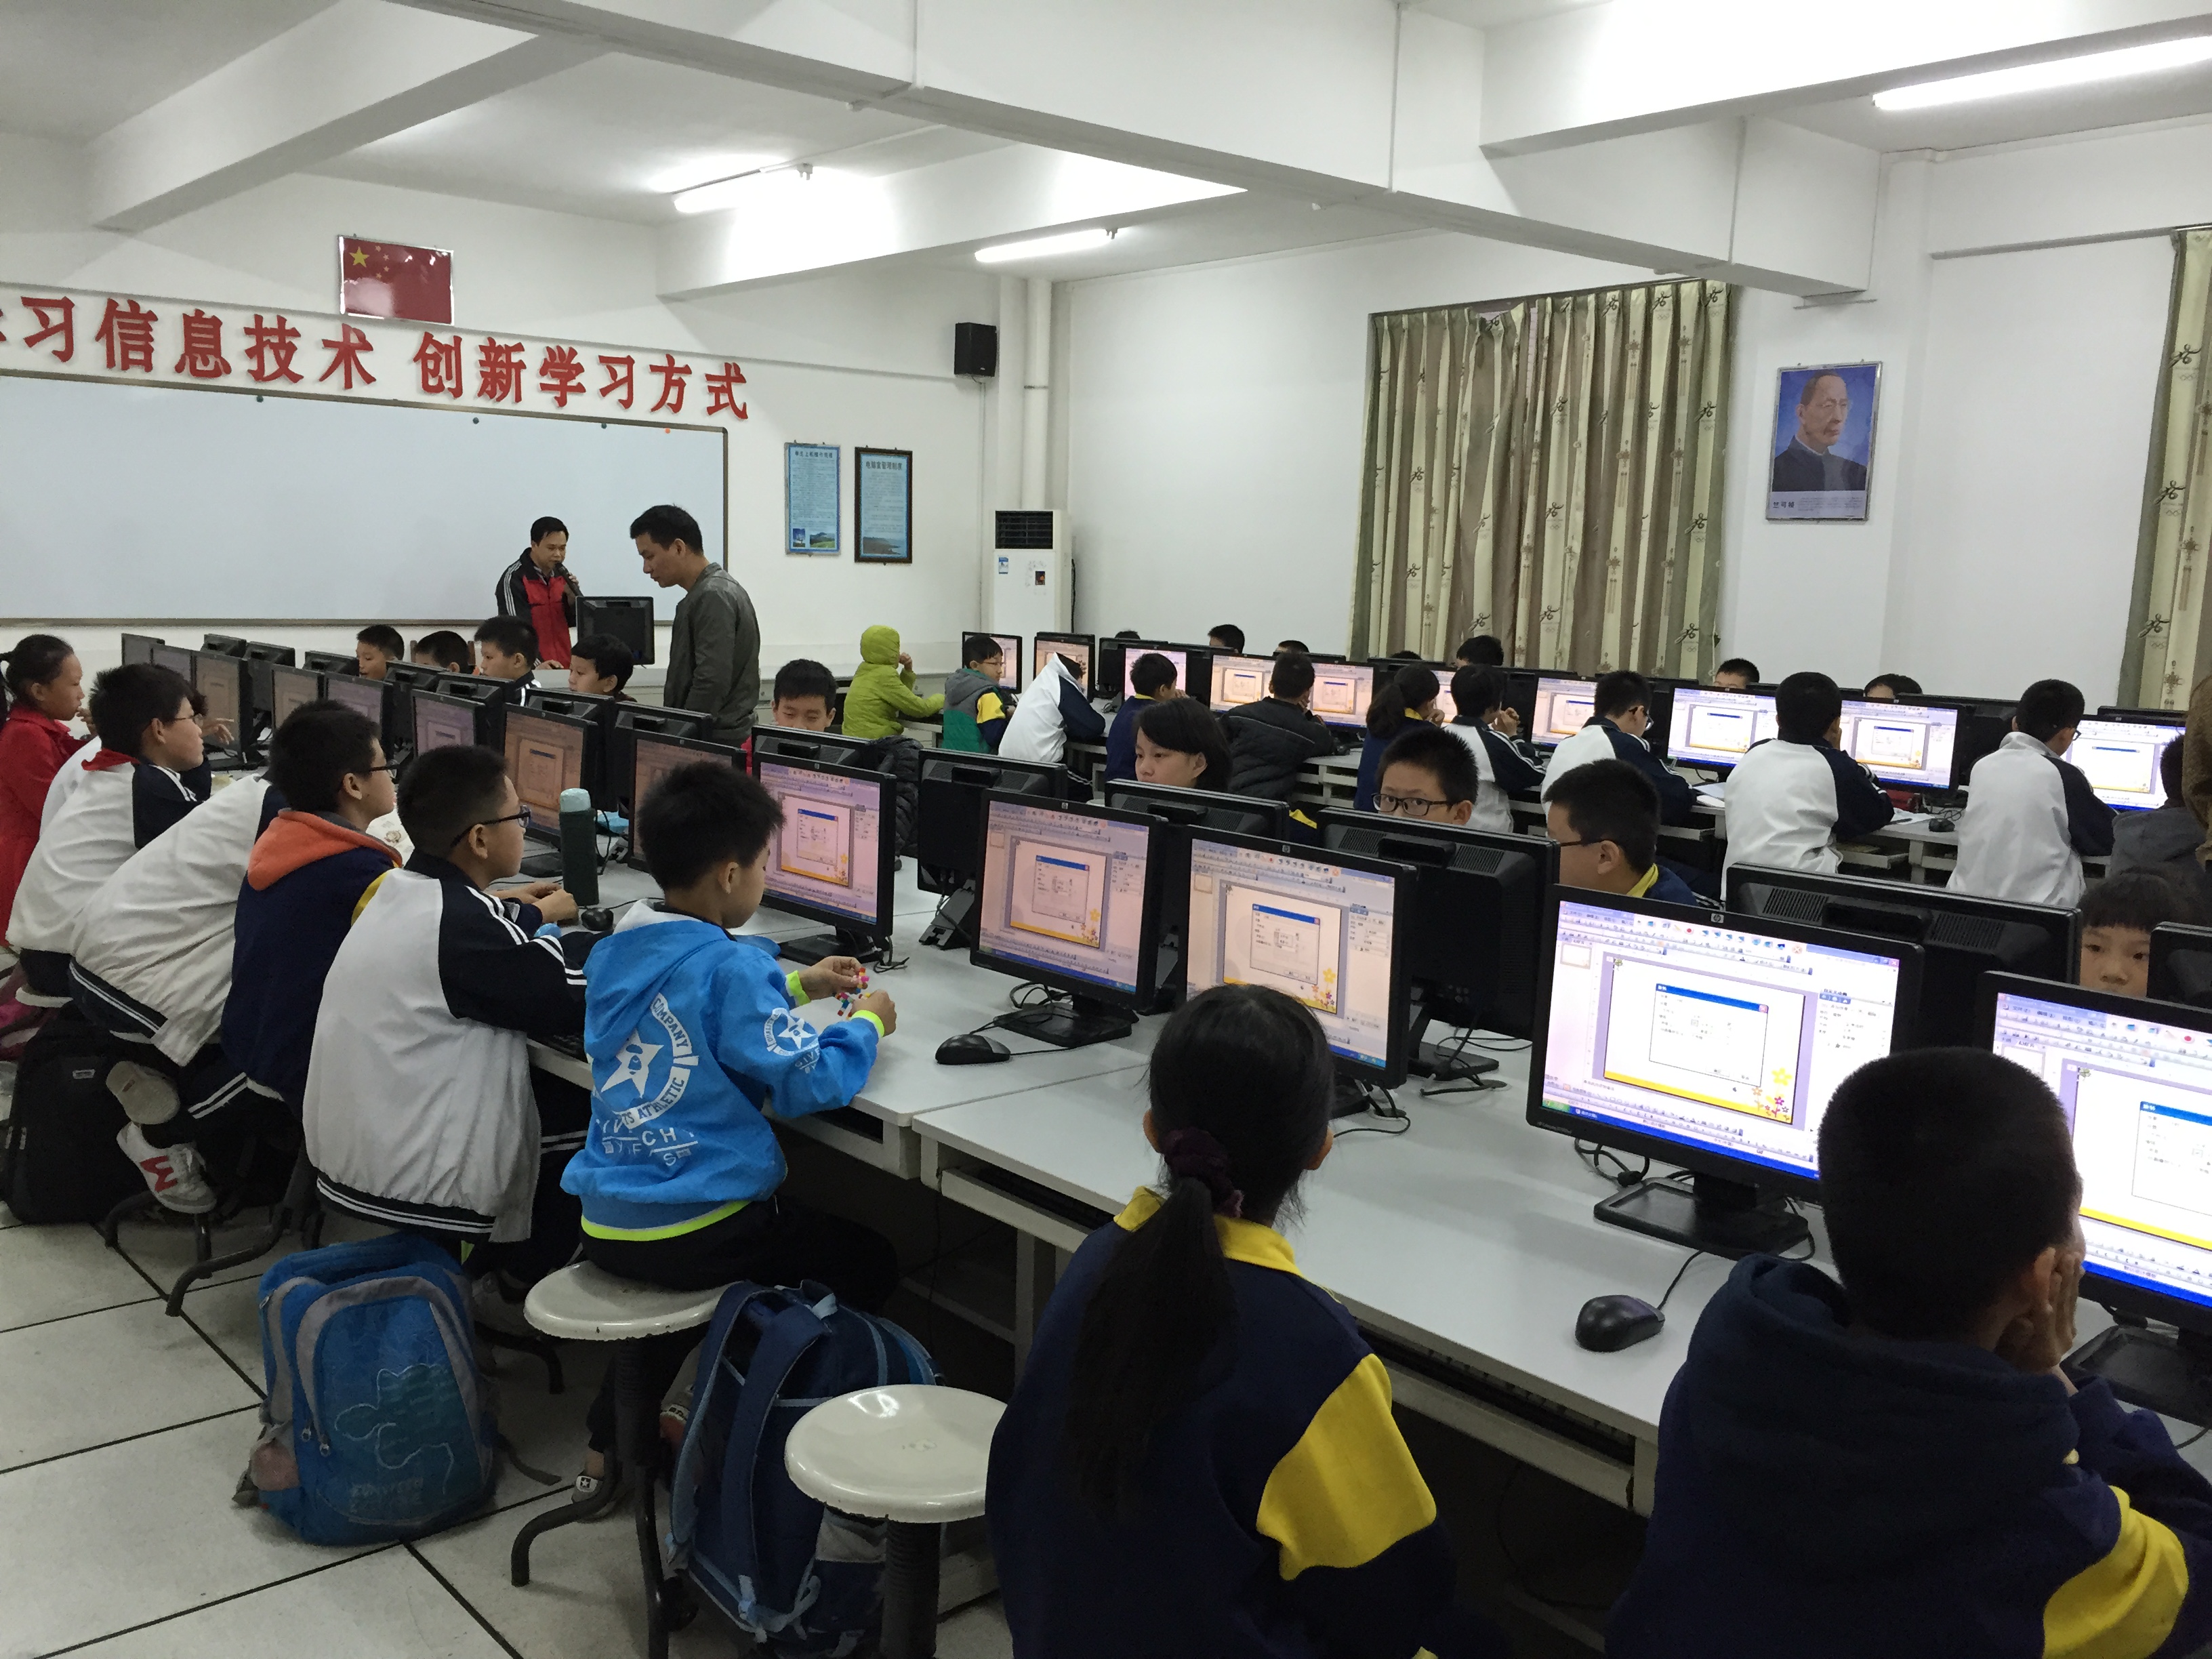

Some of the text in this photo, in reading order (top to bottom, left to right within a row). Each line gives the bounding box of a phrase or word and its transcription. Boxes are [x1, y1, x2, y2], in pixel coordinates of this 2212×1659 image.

[0, 296, 749, 419] 习信息技术 创新学习方式
[653, 998, 689, 1047] COMPANY
[637, 1077, 684, 1119] ATHLETIC
